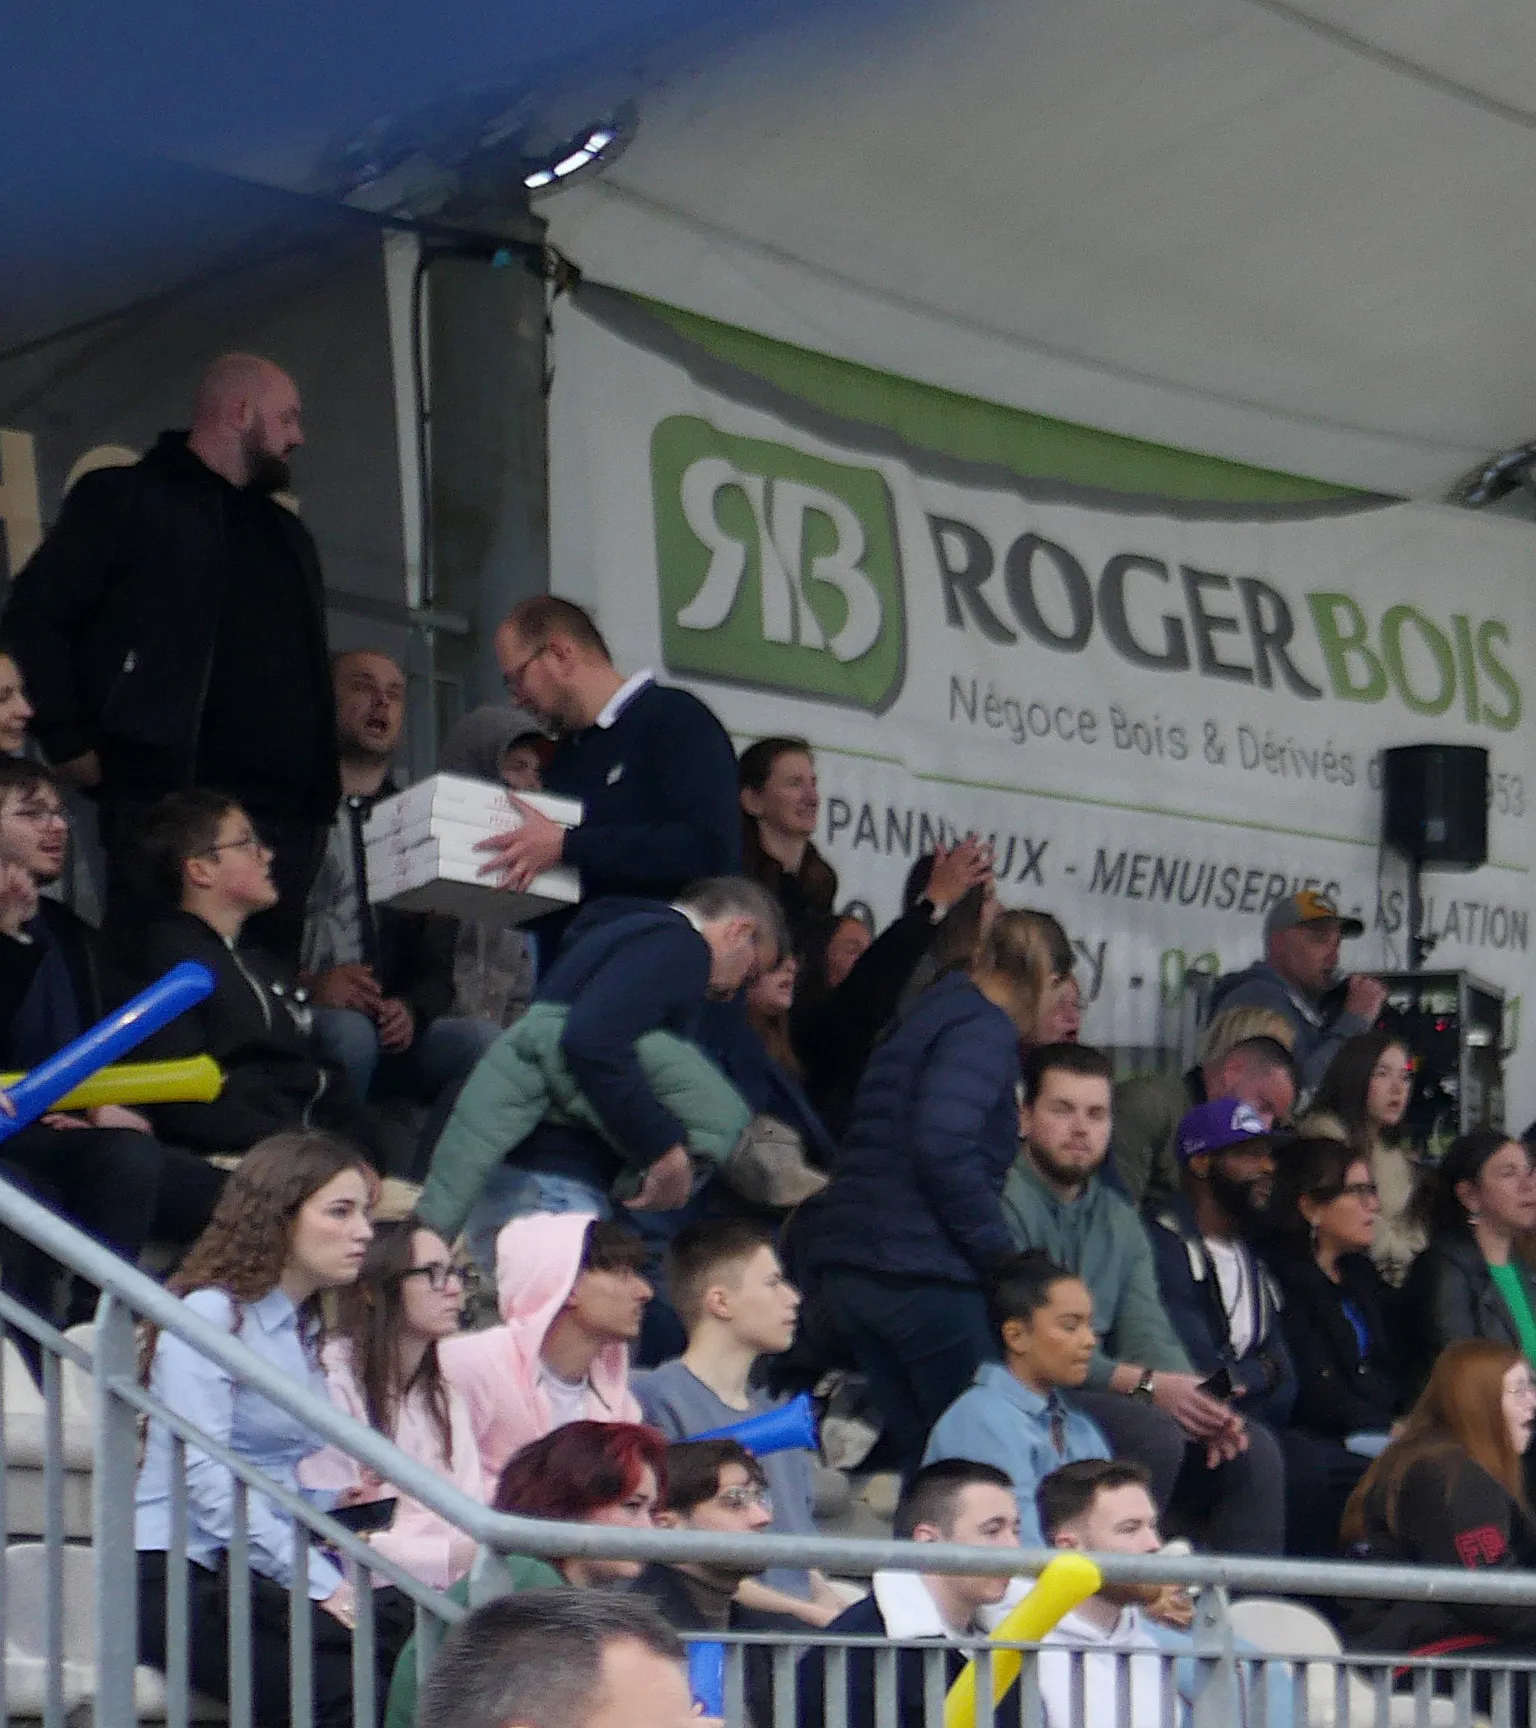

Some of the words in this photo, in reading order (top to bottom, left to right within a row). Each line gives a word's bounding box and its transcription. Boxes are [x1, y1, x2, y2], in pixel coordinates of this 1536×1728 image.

[949, 674, 1098, 746] Négoce
[1111, 713, 1188, 762] Bois
[1202, 720, 1226, 766] &
[1238, 725, 1356, 792] Dérivés
